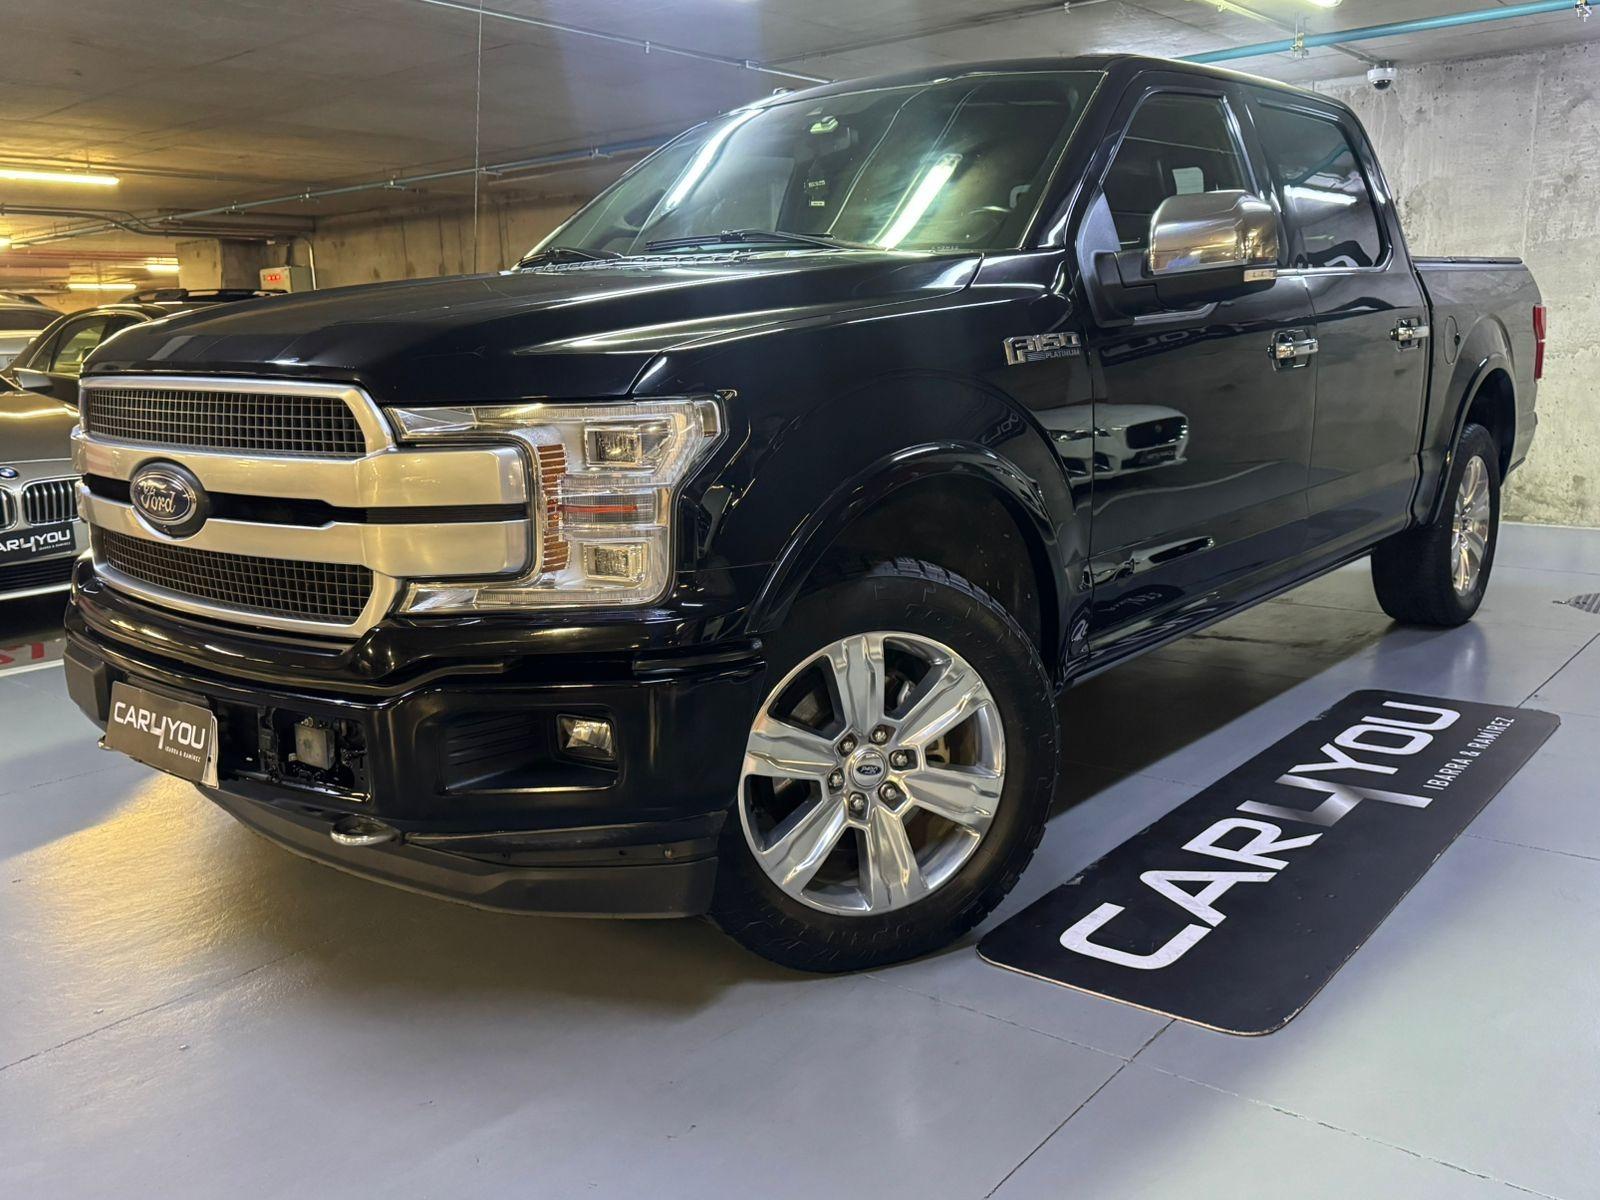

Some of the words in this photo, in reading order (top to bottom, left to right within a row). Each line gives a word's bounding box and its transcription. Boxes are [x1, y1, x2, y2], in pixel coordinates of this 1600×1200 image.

[139, 480, 176, 513] Ford
[114, 701, 206, 750] CAR4YOU
[1422, 758, 1473, 790] IBARRA
[1467, 716, 1516, 750] RAMÍREZ
[1060, 701, 1461, 970] CAR4YOU
